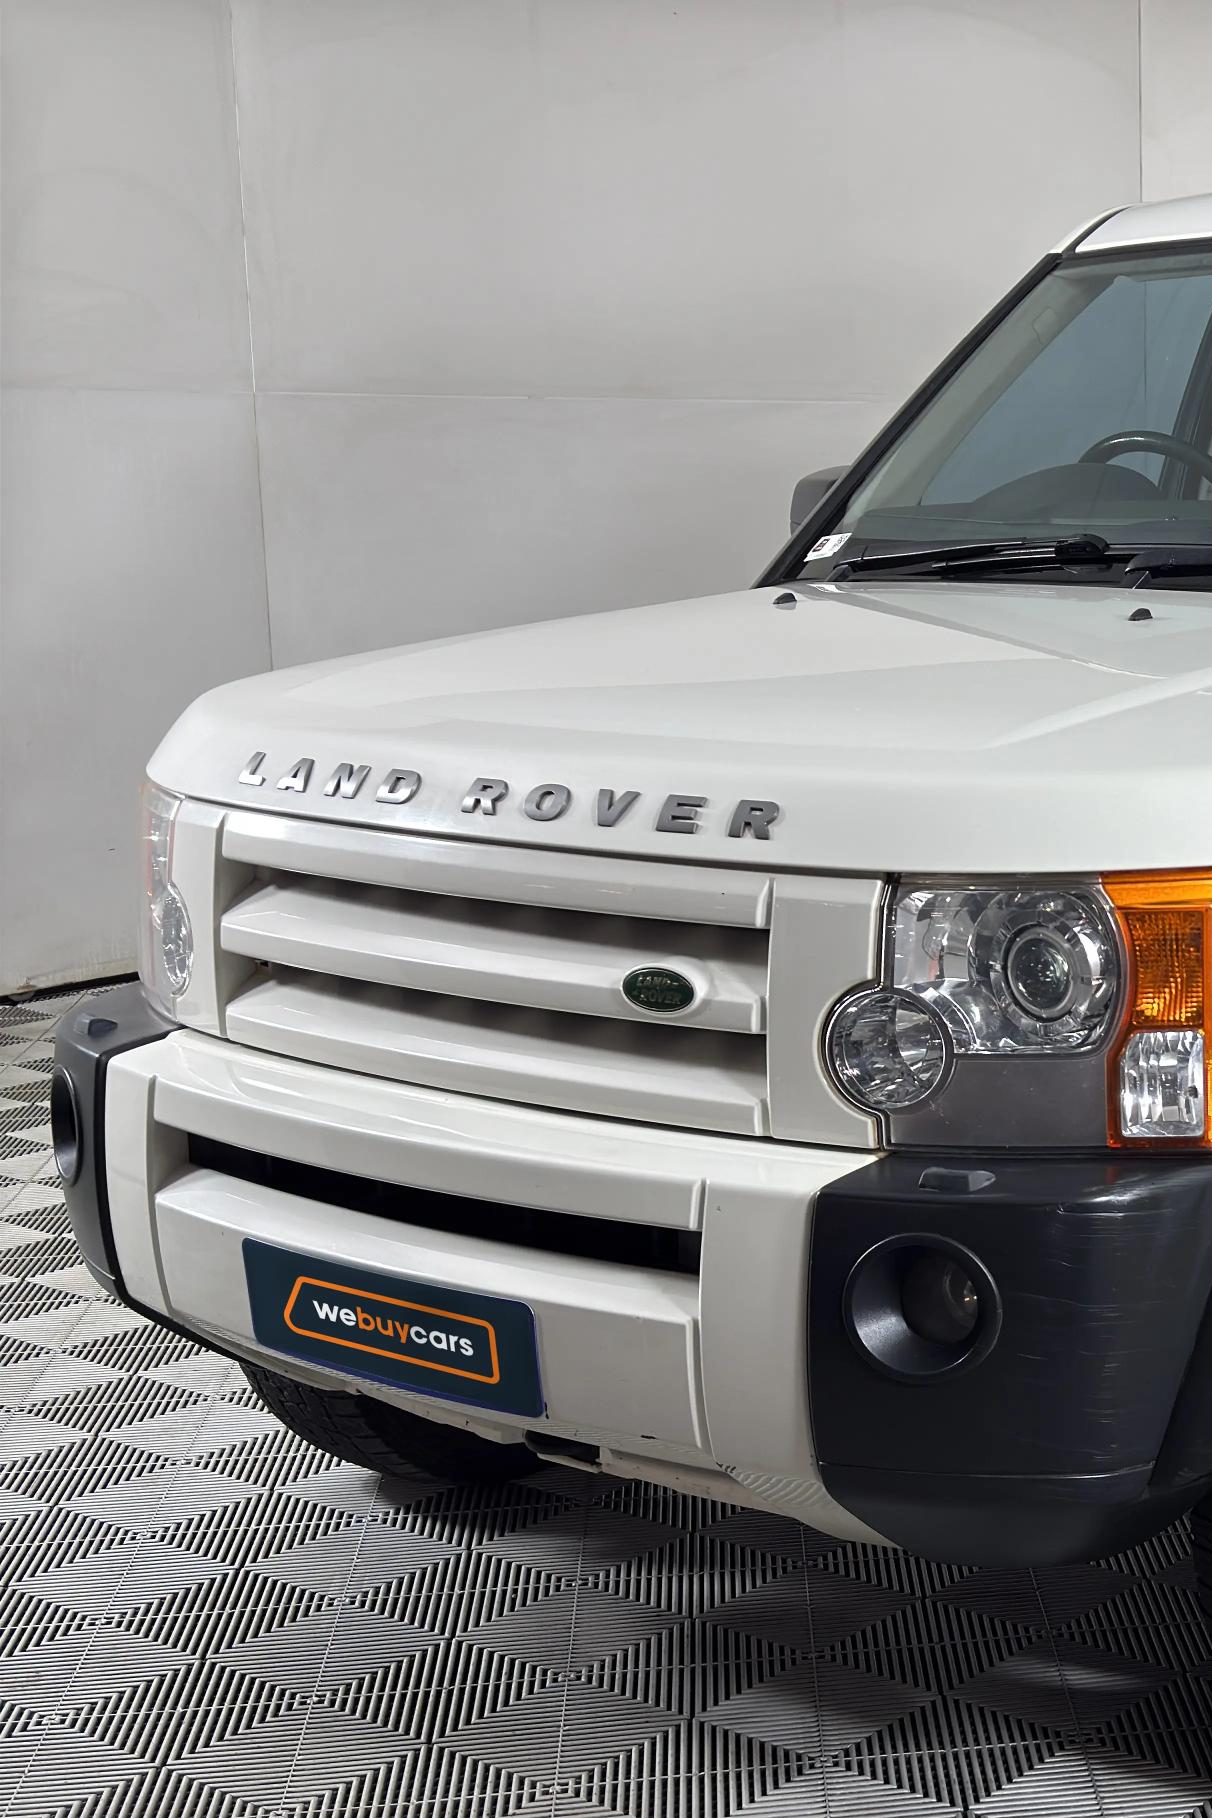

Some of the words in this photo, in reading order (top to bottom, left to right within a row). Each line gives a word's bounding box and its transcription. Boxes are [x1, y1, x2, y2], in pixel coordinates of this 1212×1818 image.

[238, 751, 423, 803] LAND
[460, 777, 780, 840] ROVER
[312, 1300, 475, 1357] webuycars
